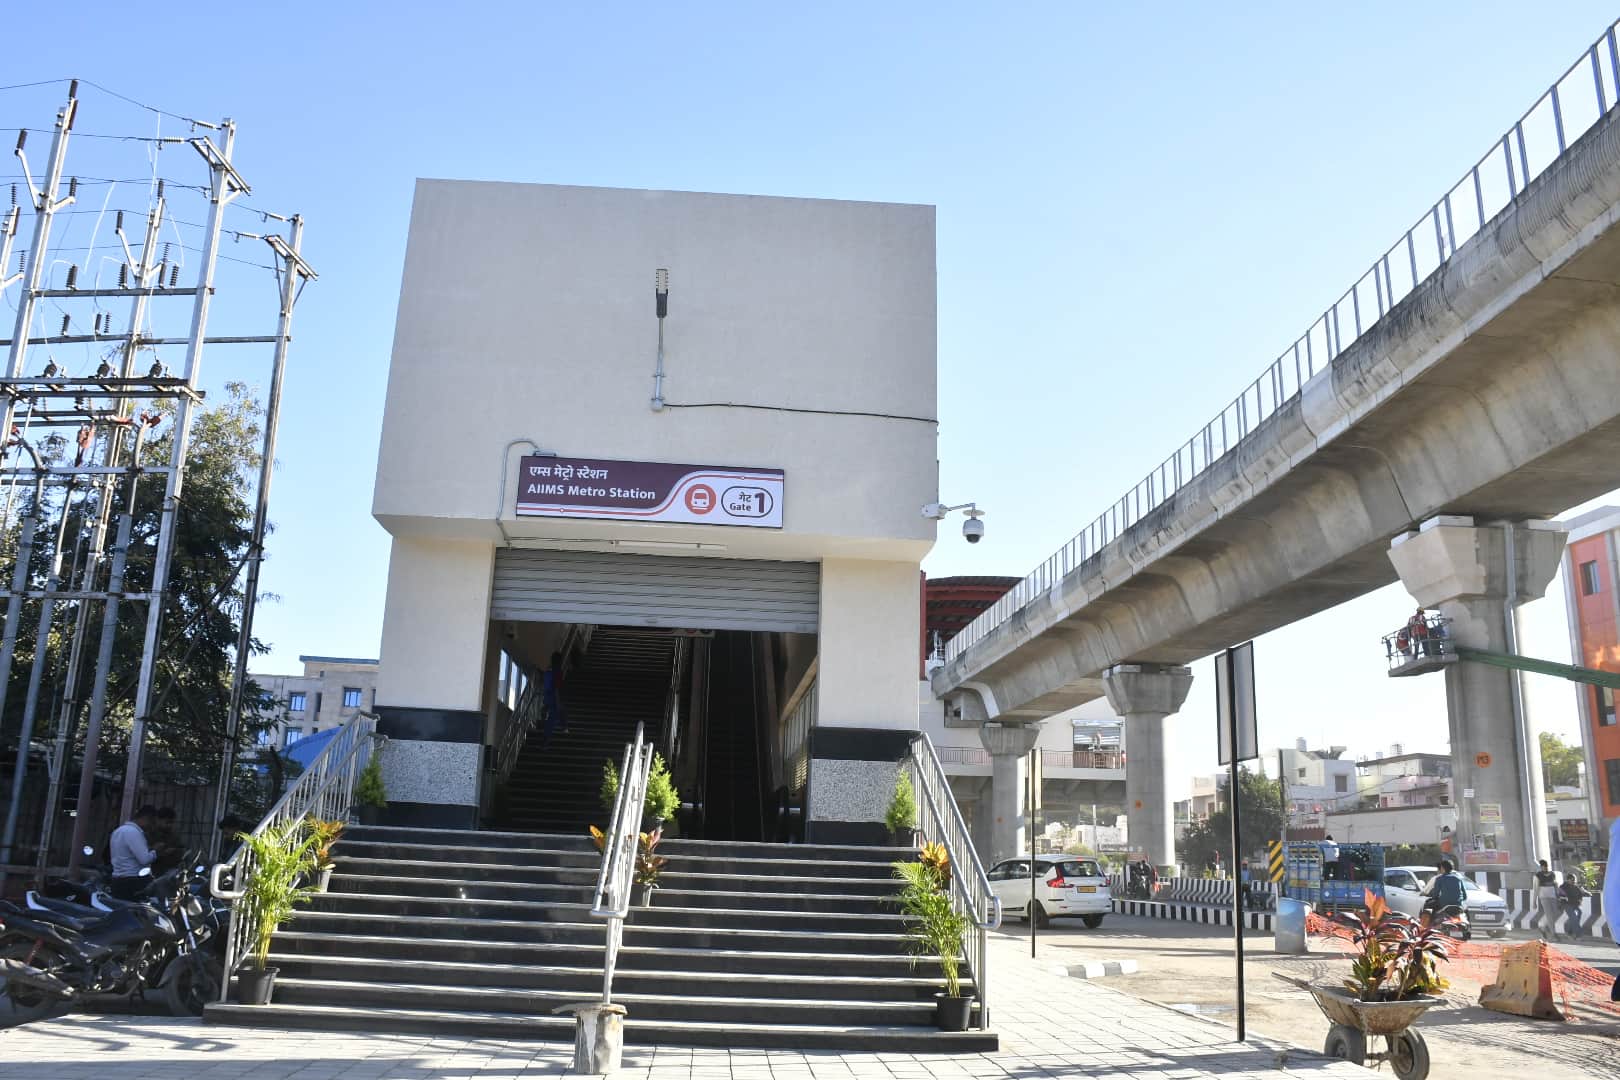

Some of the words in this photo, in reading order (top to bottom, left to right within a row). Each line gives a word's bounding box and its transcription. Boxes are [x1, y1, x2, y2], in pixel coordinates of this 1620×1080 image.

[529, 466, 552, 477] एम्स
[554, 464, 574, 481] मेट्रो
[576, 465, 609, 480] स्टेशन
[527, 483, 565, 495] AIIMS
[568, 485, 606, 497] Metro
[609, 487, 656, 500] Station
[739, 491, 752, 502] गेट
[729, 502, 752, 511] Gate
[754, 492, 765, 513] 1
